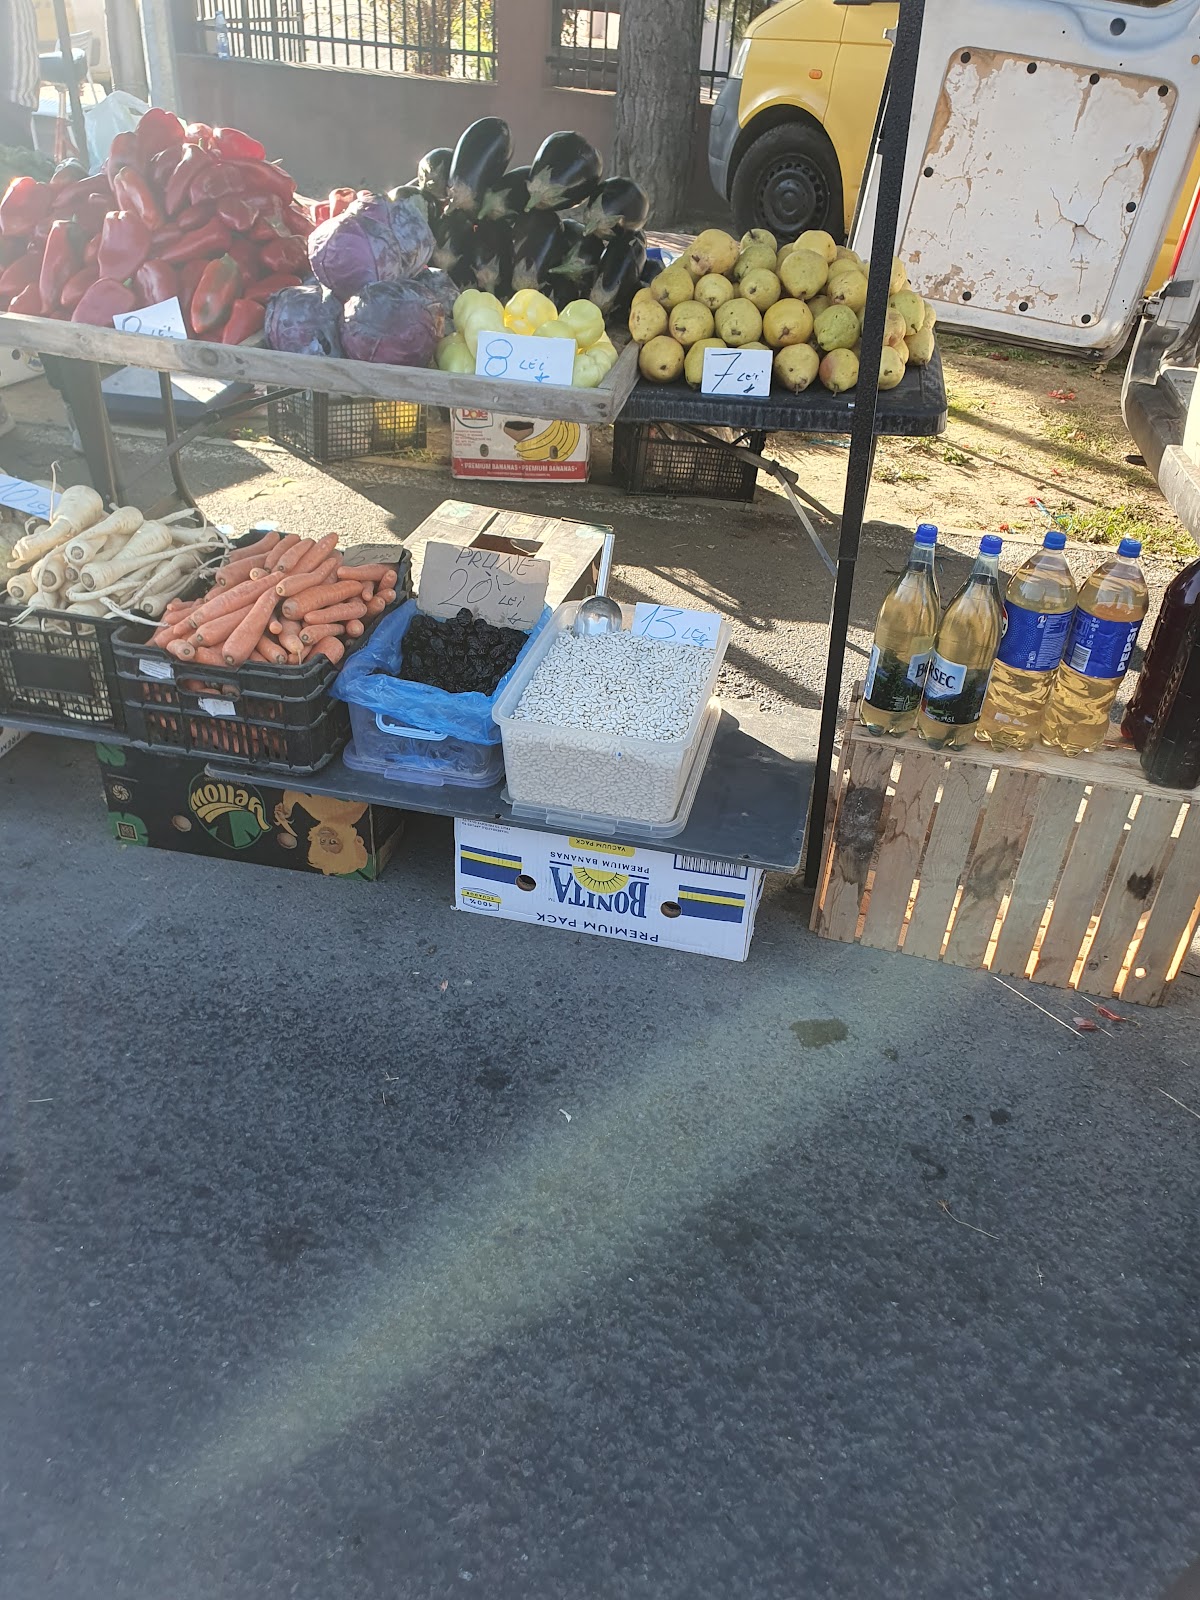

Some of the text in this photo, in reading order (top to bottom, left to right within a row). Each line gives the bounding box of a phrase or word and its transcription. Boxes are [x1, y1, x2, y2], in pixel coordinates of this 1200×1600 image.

[484, 338, 514, 378] 8
[711, 352, 742, 393] 7
[464, 462, 491, 470] PREMIUM
[491, 463, 518, 471] BANANAS
[521, 464, 548, 472] PREMIUM
[455, 546, 542, 576] PRUNE
[438, 568, 493, 608] 20
[641, 605, 684, 640] 13
[1116, 626, 1139, 672] PEPSI
[191, 784, 270, 830] yellow
[550, 851, 650, 874] PREMIUM BANANAS
[575, 838, 626, 852] VACUUM PACK
[469, 898, 493, 908] 100%
[549, 866, 650, 918] BONITA
[536, 911, 659, 943] PREMIUM PACK
